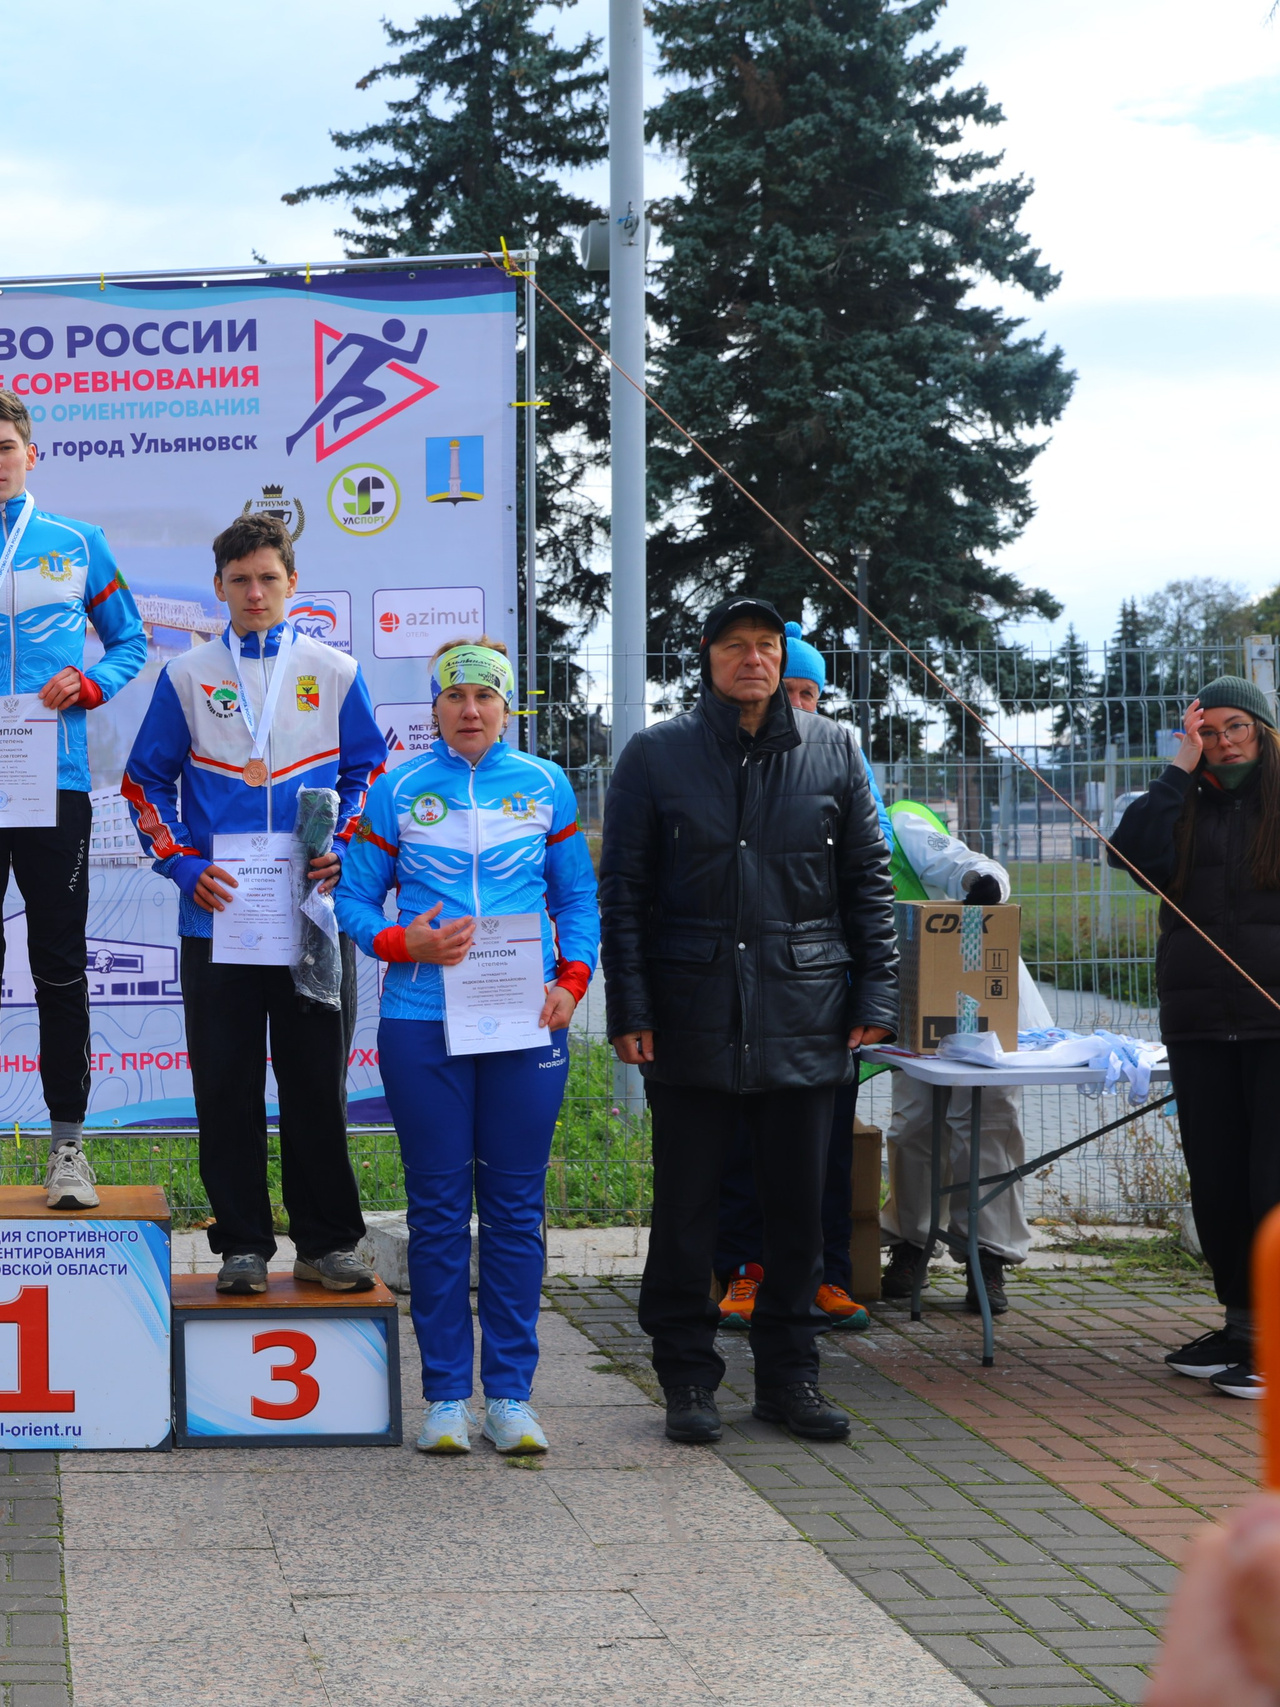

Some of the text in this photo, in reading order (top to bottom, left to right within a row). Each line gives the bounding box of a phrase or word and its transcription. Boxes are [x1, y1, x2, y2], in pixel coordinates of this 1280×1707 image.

[66, 319, 257, 358] РОССИИ
[12, 365, 259, 395] СОРЕВНОВАНИЯ
[51, 398, 260, 422] ОРИЕНТИРОВАНИЯ
[53, 440, 124, 462] город
[130, 432, 258, 454] Ульяновск
[255, 500, 291, 508] ТРИУМФ
[342, 515, 386, 525] УЛСПОРТ
[405, 607, 479, 625] azimut
[237, 867, 283, 876] ДИПЛОМ
[468, 948, 517, 961] ДИПЛОМ
[929, 1024, 941, 1041] L
[25, 1229, 139, 1243] СПОРТИВНОГО
[56, 1263, 128, 1276] ОБЛАСТИ
[250, 1328, 320, 1421] 3
